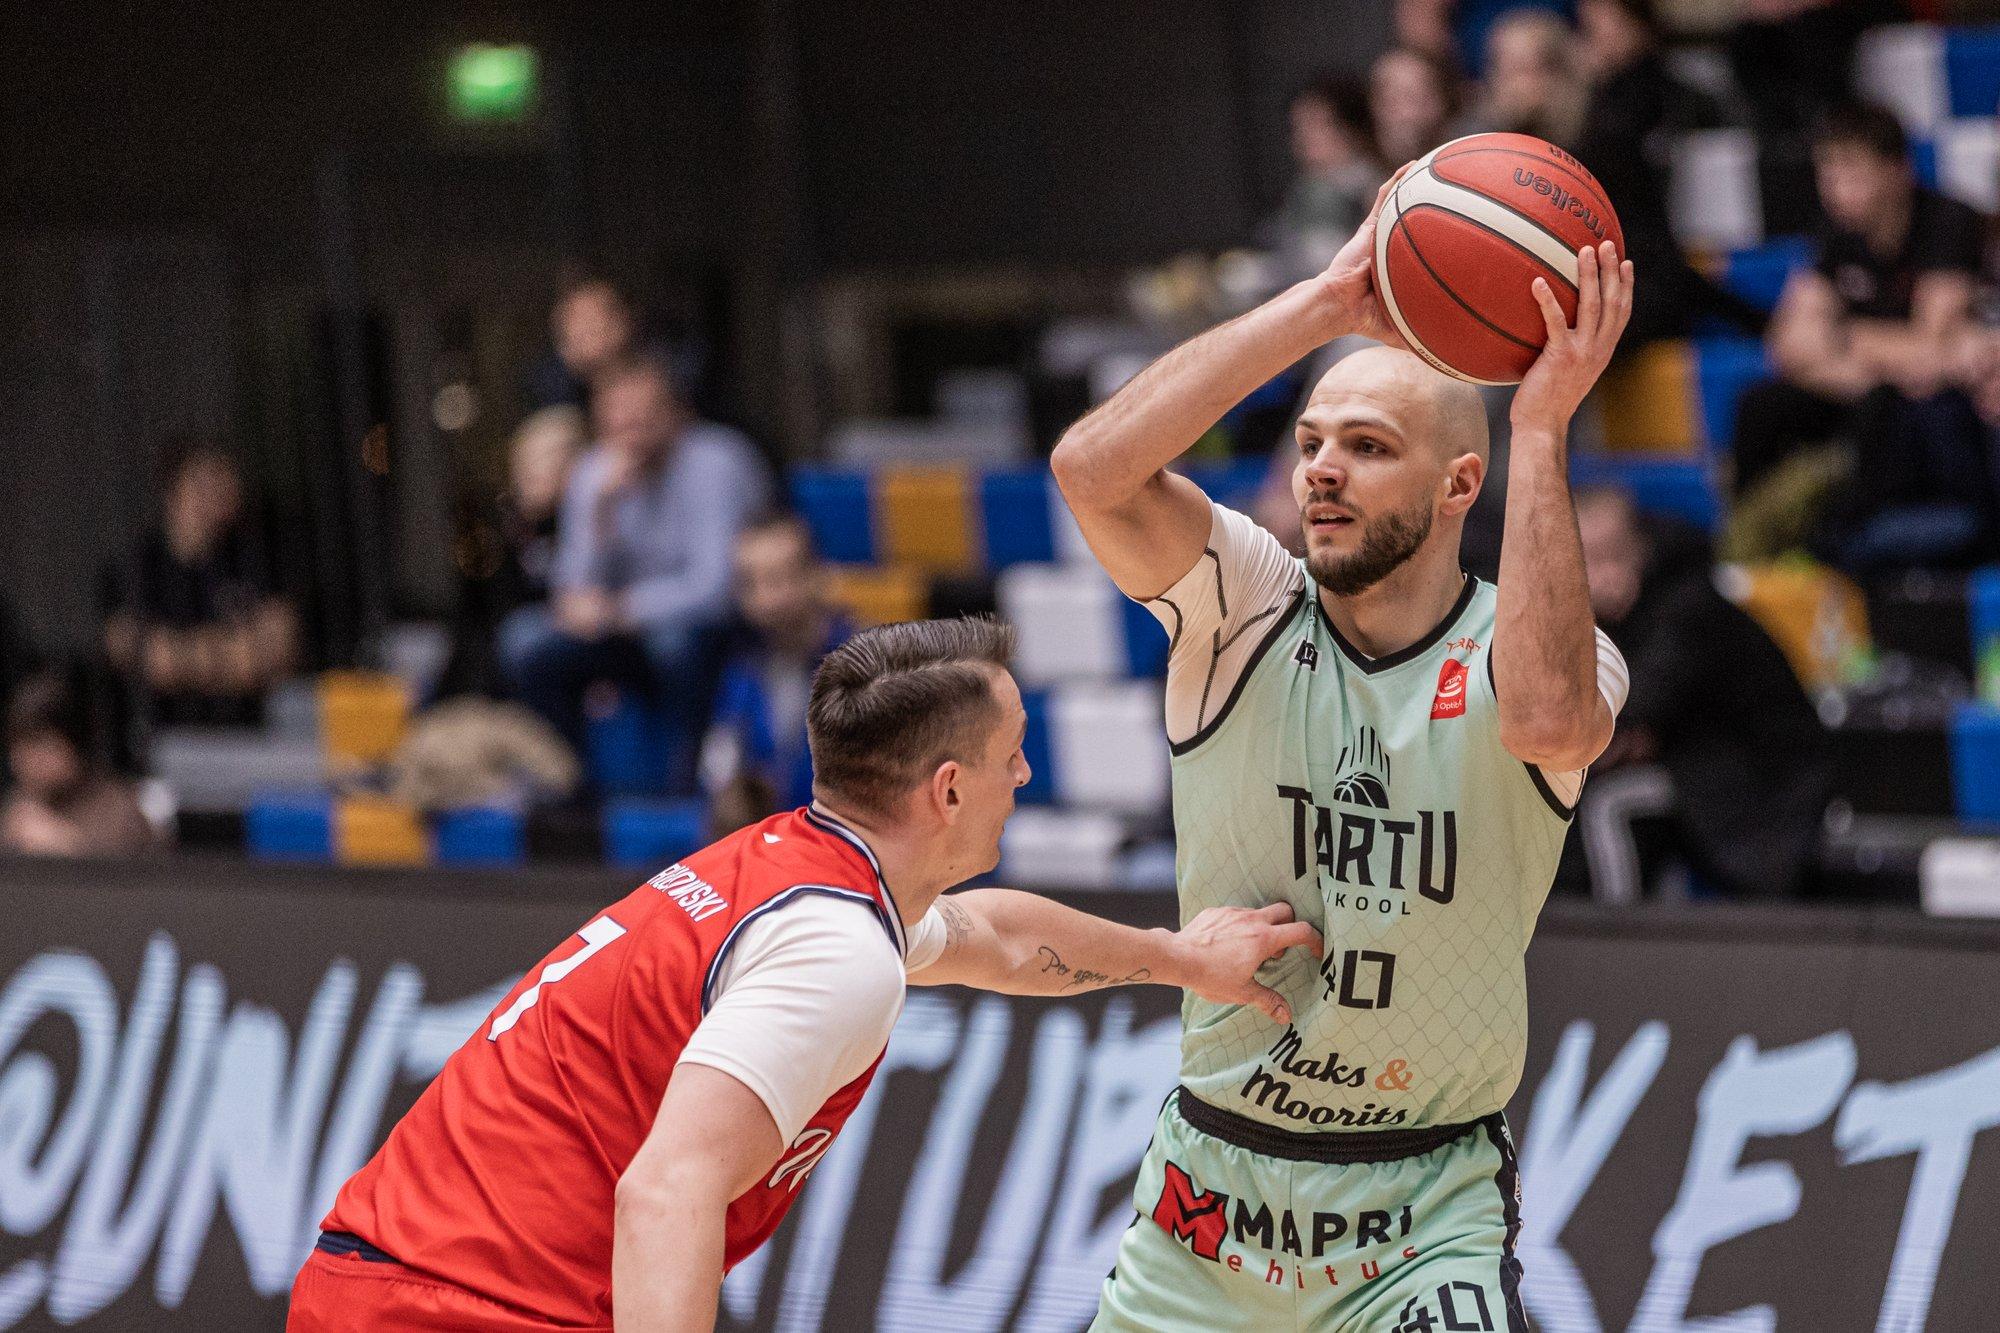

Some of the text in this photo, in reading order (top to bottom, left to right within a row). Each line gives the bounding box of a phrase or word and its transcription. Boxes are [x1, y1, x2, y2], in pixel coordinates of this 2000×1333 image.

[1513, 167, 1606, 239] molten
[1276, 784, 1458, 905] TARTU
[487, 914, 628, 1043] 7
[1268, 1022, 1414, 1092] Maks &
[1240, 1064, 1408, 1127] Moorits
[1233, 1197, 1413, 1258] MAPRI
[1226, 1245, 1419, 1289] ehitus
